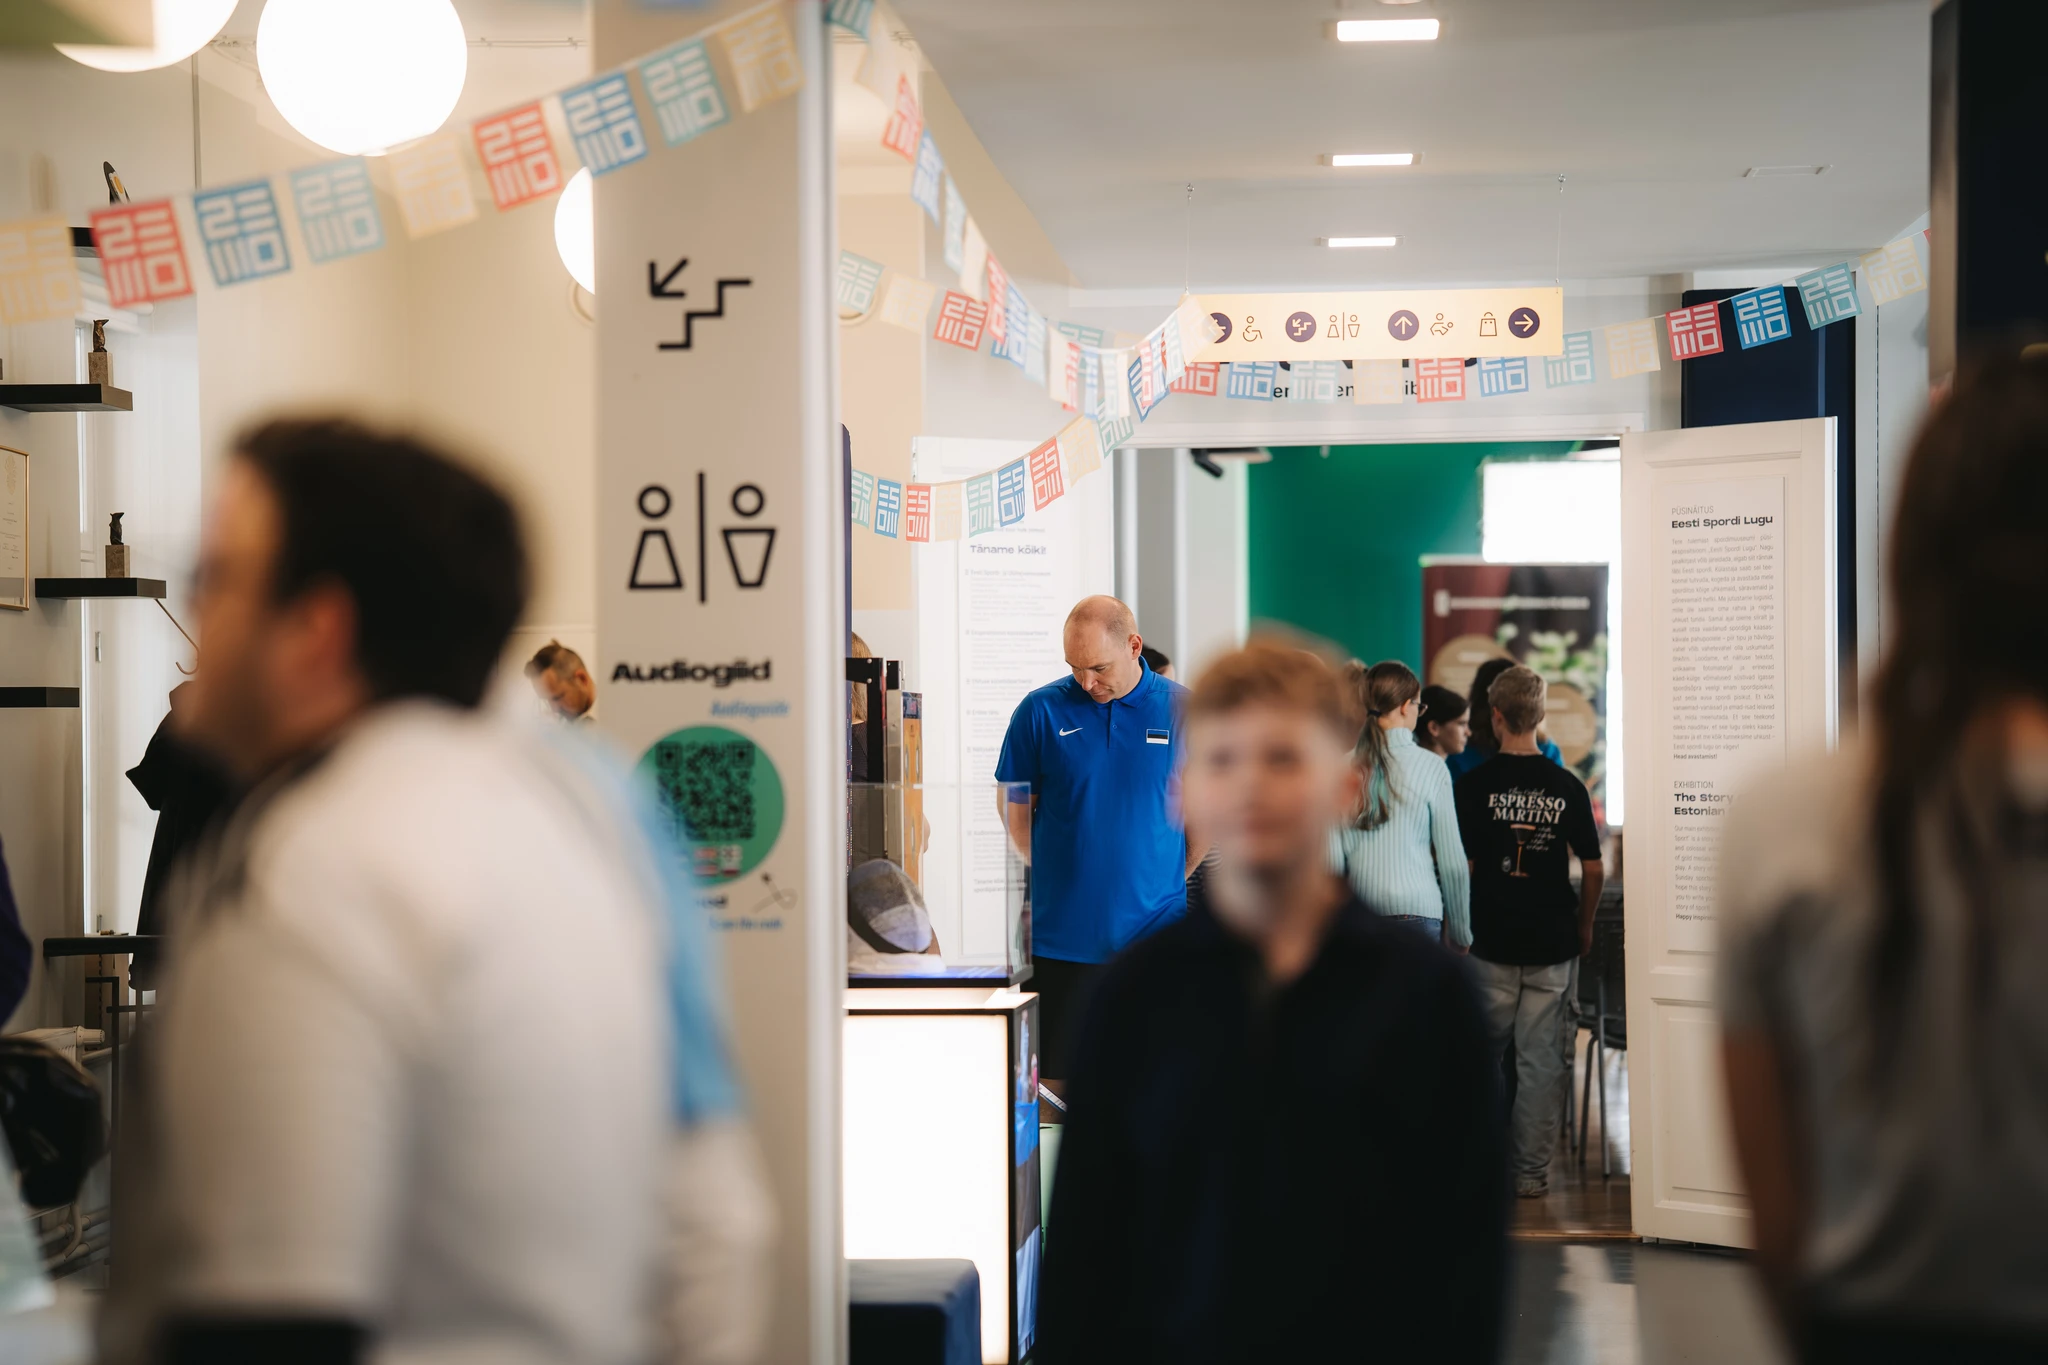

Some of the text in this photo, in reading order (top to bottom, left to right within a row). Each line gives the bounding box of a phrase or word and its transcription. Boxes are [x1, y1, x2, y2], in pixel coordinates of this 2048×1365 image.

[1672, 506, 1714, 515] PÜSINÄITUS
[1672, 516, 1773, 529] Eesti Spordi Lugu
[970, 544, 1014, 554] Täname
[611, 658, 771, 688] Audiogiid
[1674, 781, 1713, 789] EXHIBITION
[1488, 793, 1566, 812] ESPRESSO
[1674, 793, 1733, 804] The Story
[1493, 807, 1561, 824] MARTINI
[1674, 806, 1725, 815] Estonian
